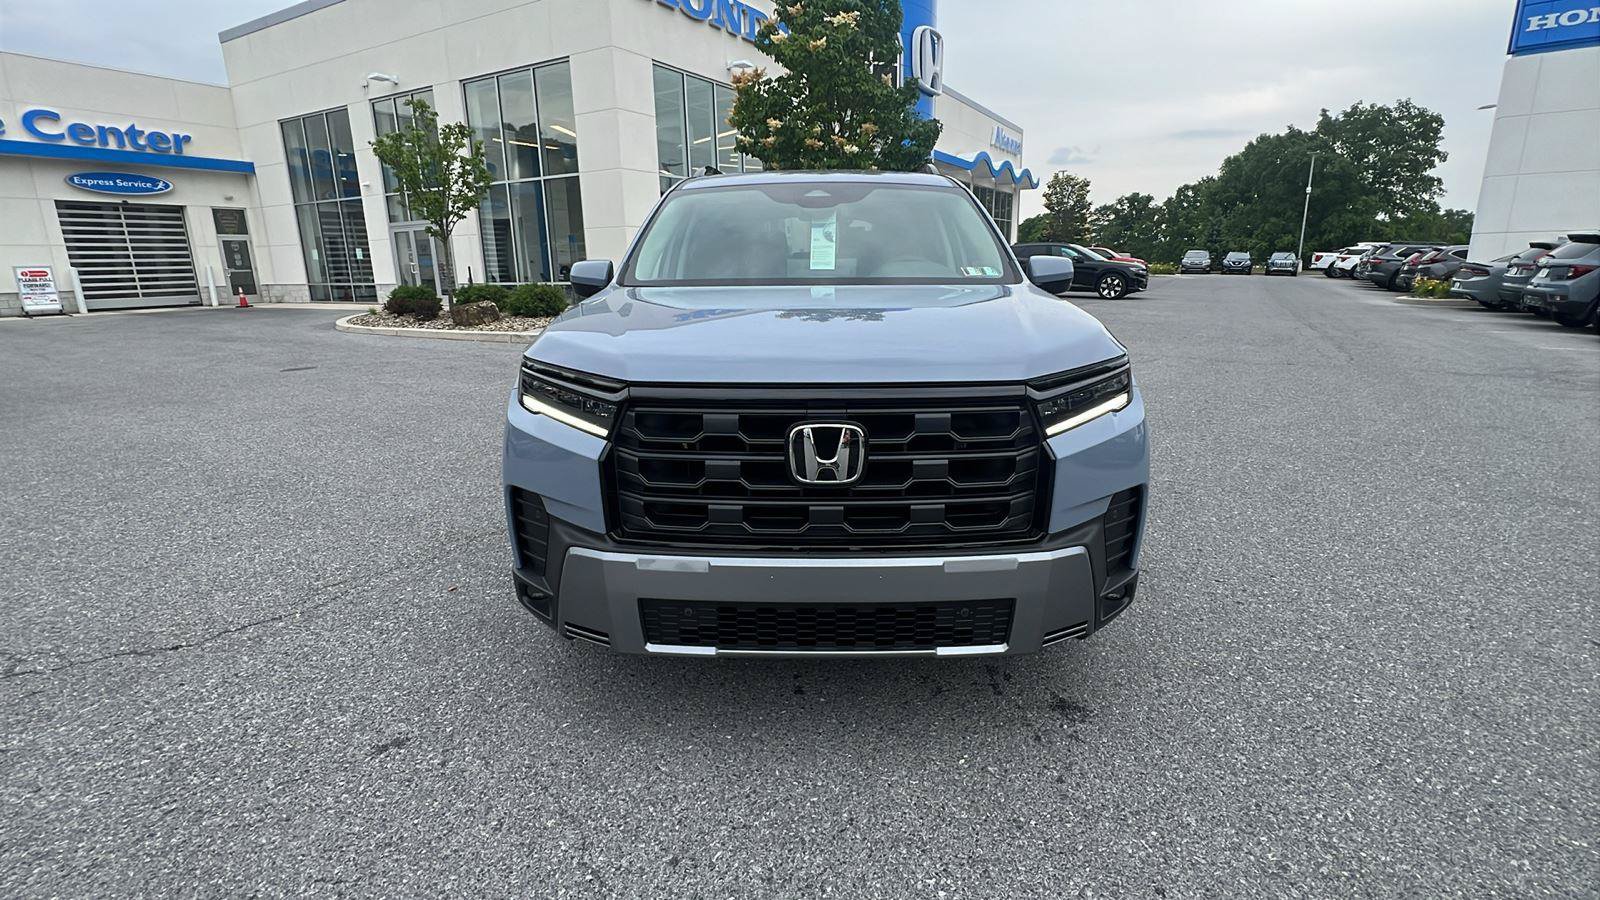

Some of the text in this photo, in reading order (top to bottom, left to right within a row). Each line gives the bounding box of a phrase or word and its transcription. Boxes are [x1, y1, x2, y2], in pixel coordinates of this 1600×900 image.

[22, 109, 191, 154] Center
[73, 176, 152, 188] Express Service
